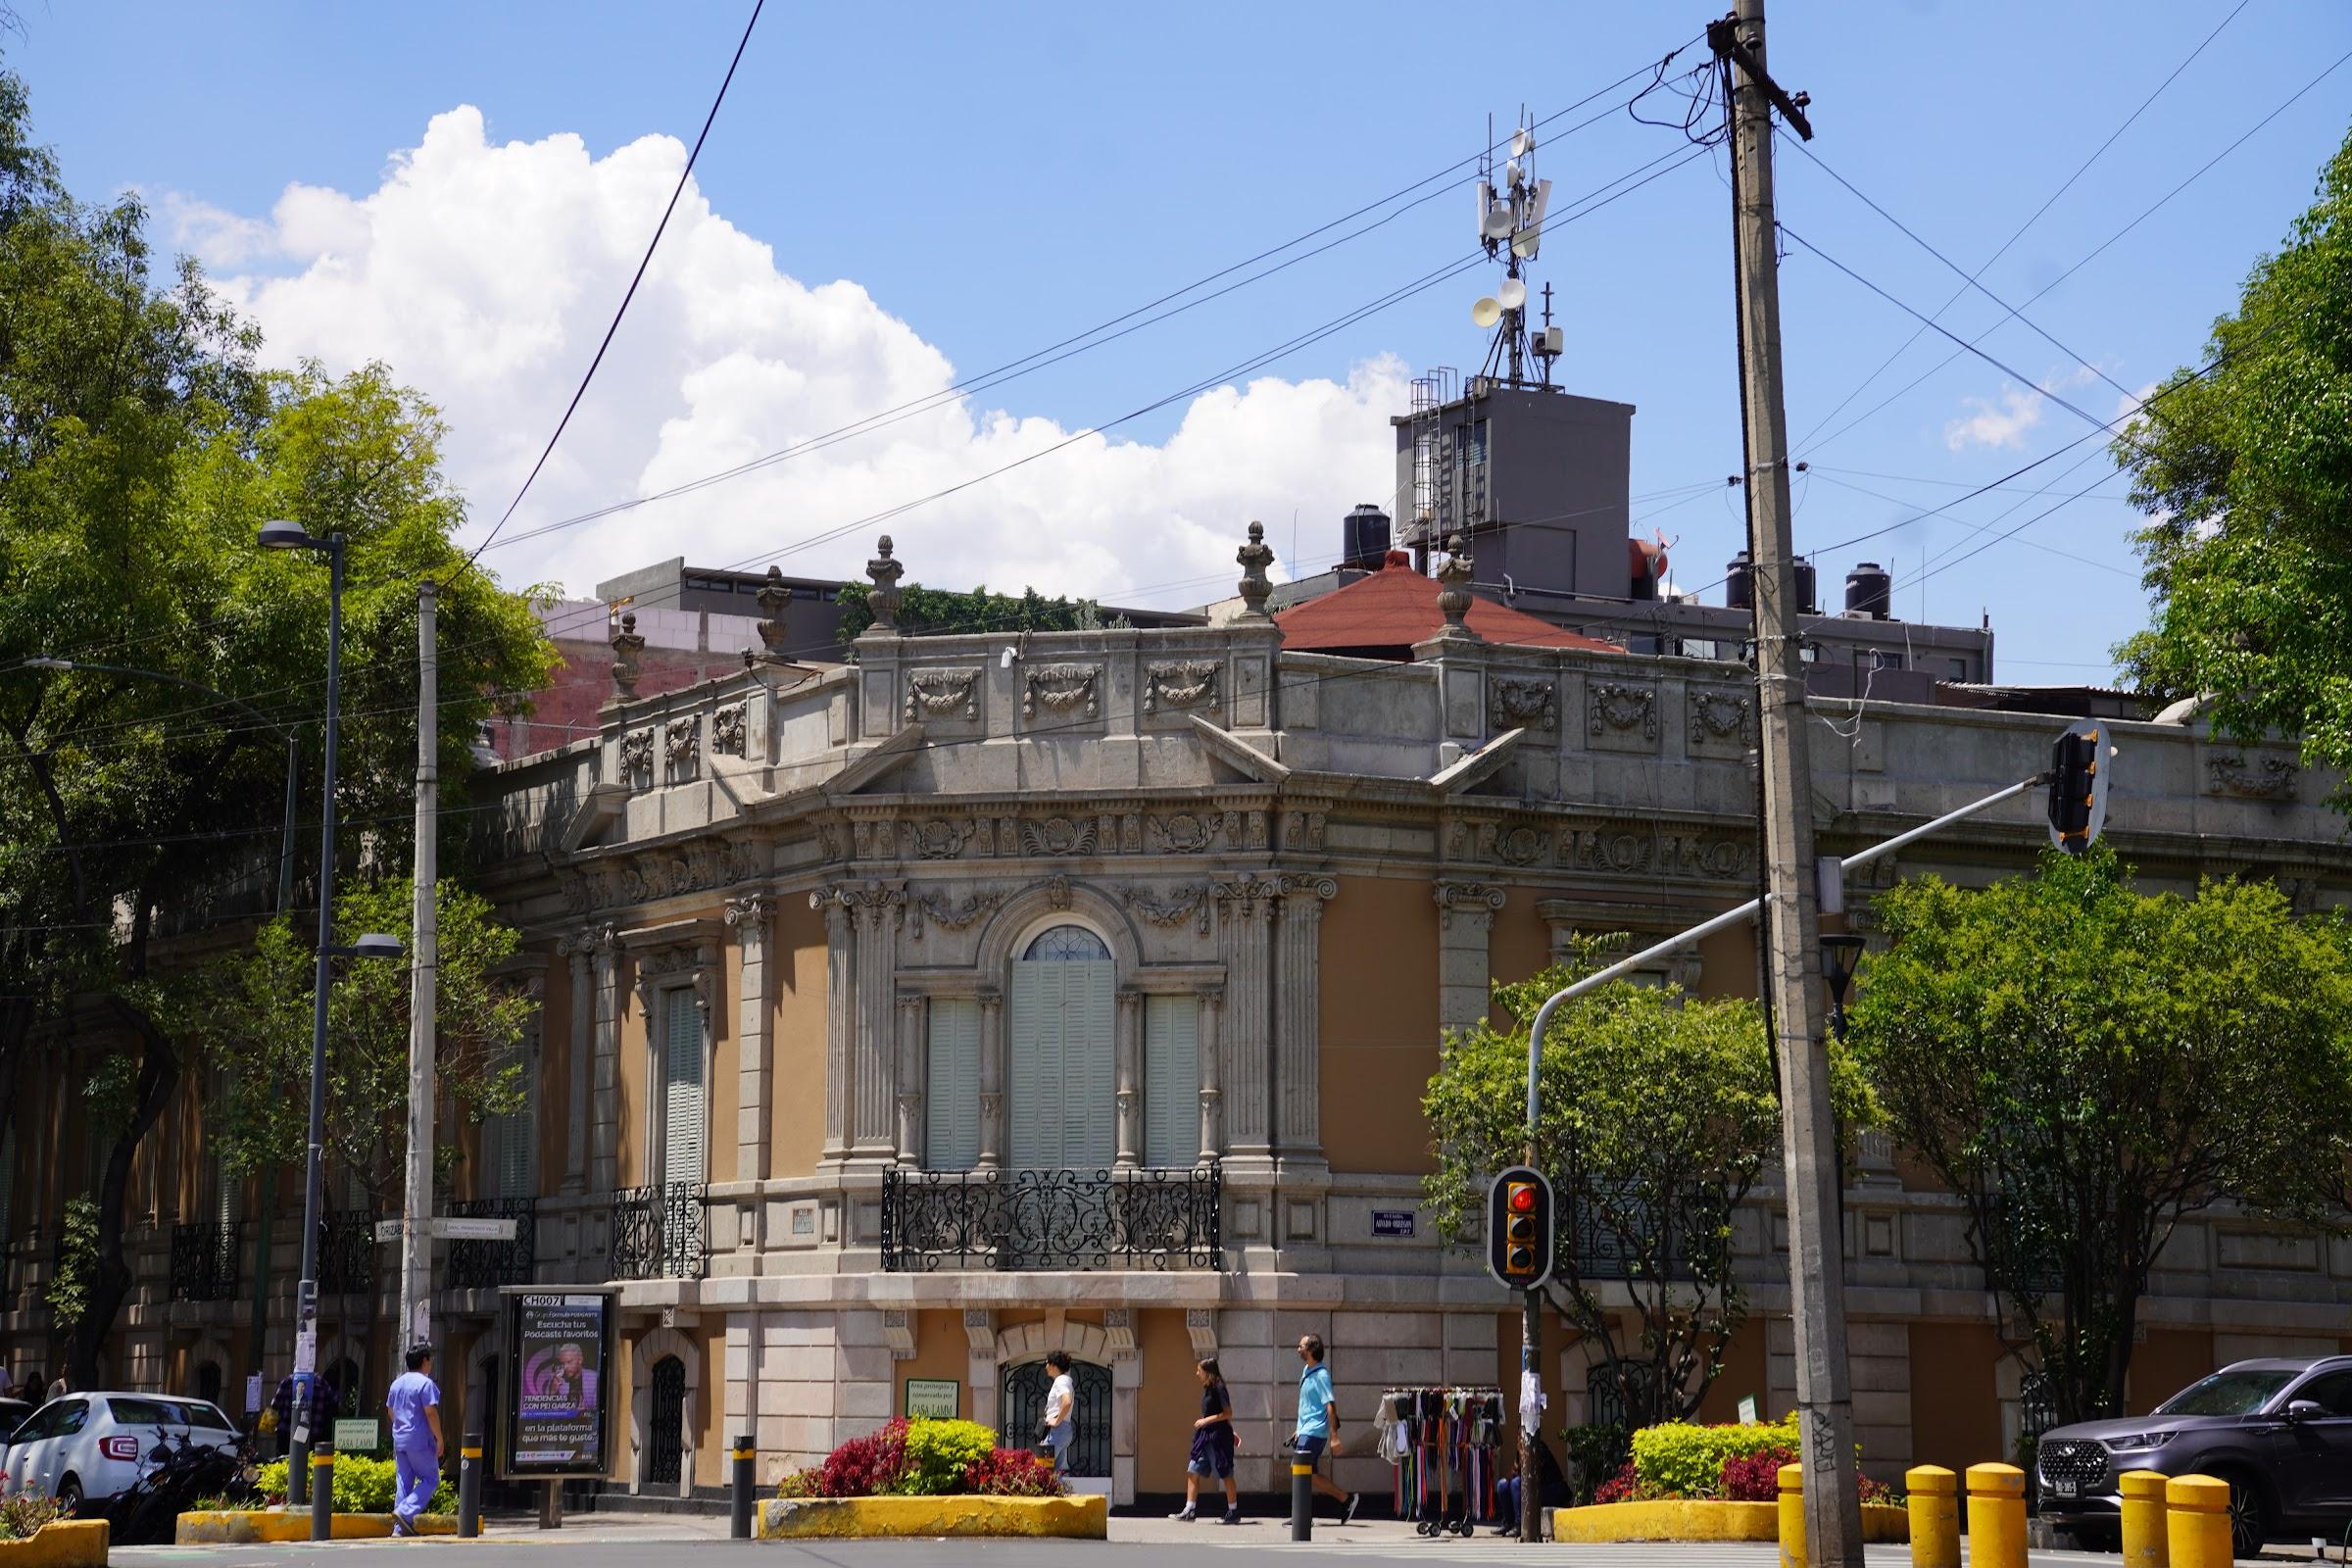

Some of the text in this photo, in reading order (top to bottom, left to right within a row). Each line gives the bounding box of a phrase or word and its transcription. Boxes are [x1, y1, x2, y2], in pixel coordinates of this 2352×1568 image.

[380, 1223, 403, 1237] ORIZAB
[523, 1296, 560, 1305] CH007
[537, 1320, 587, 1329] Escucha tus
[524, 1330, 599, 1339] Podcasts favoritos
[911, 1404, 953, 1416] CASA LAMM
[537, 1423, 545, 1432] la
[546, 1423, 593, 1434] plataforma
[338, 1438, 374, 1448] CASA LAMM
[522, 1435, 538, 1444] que
